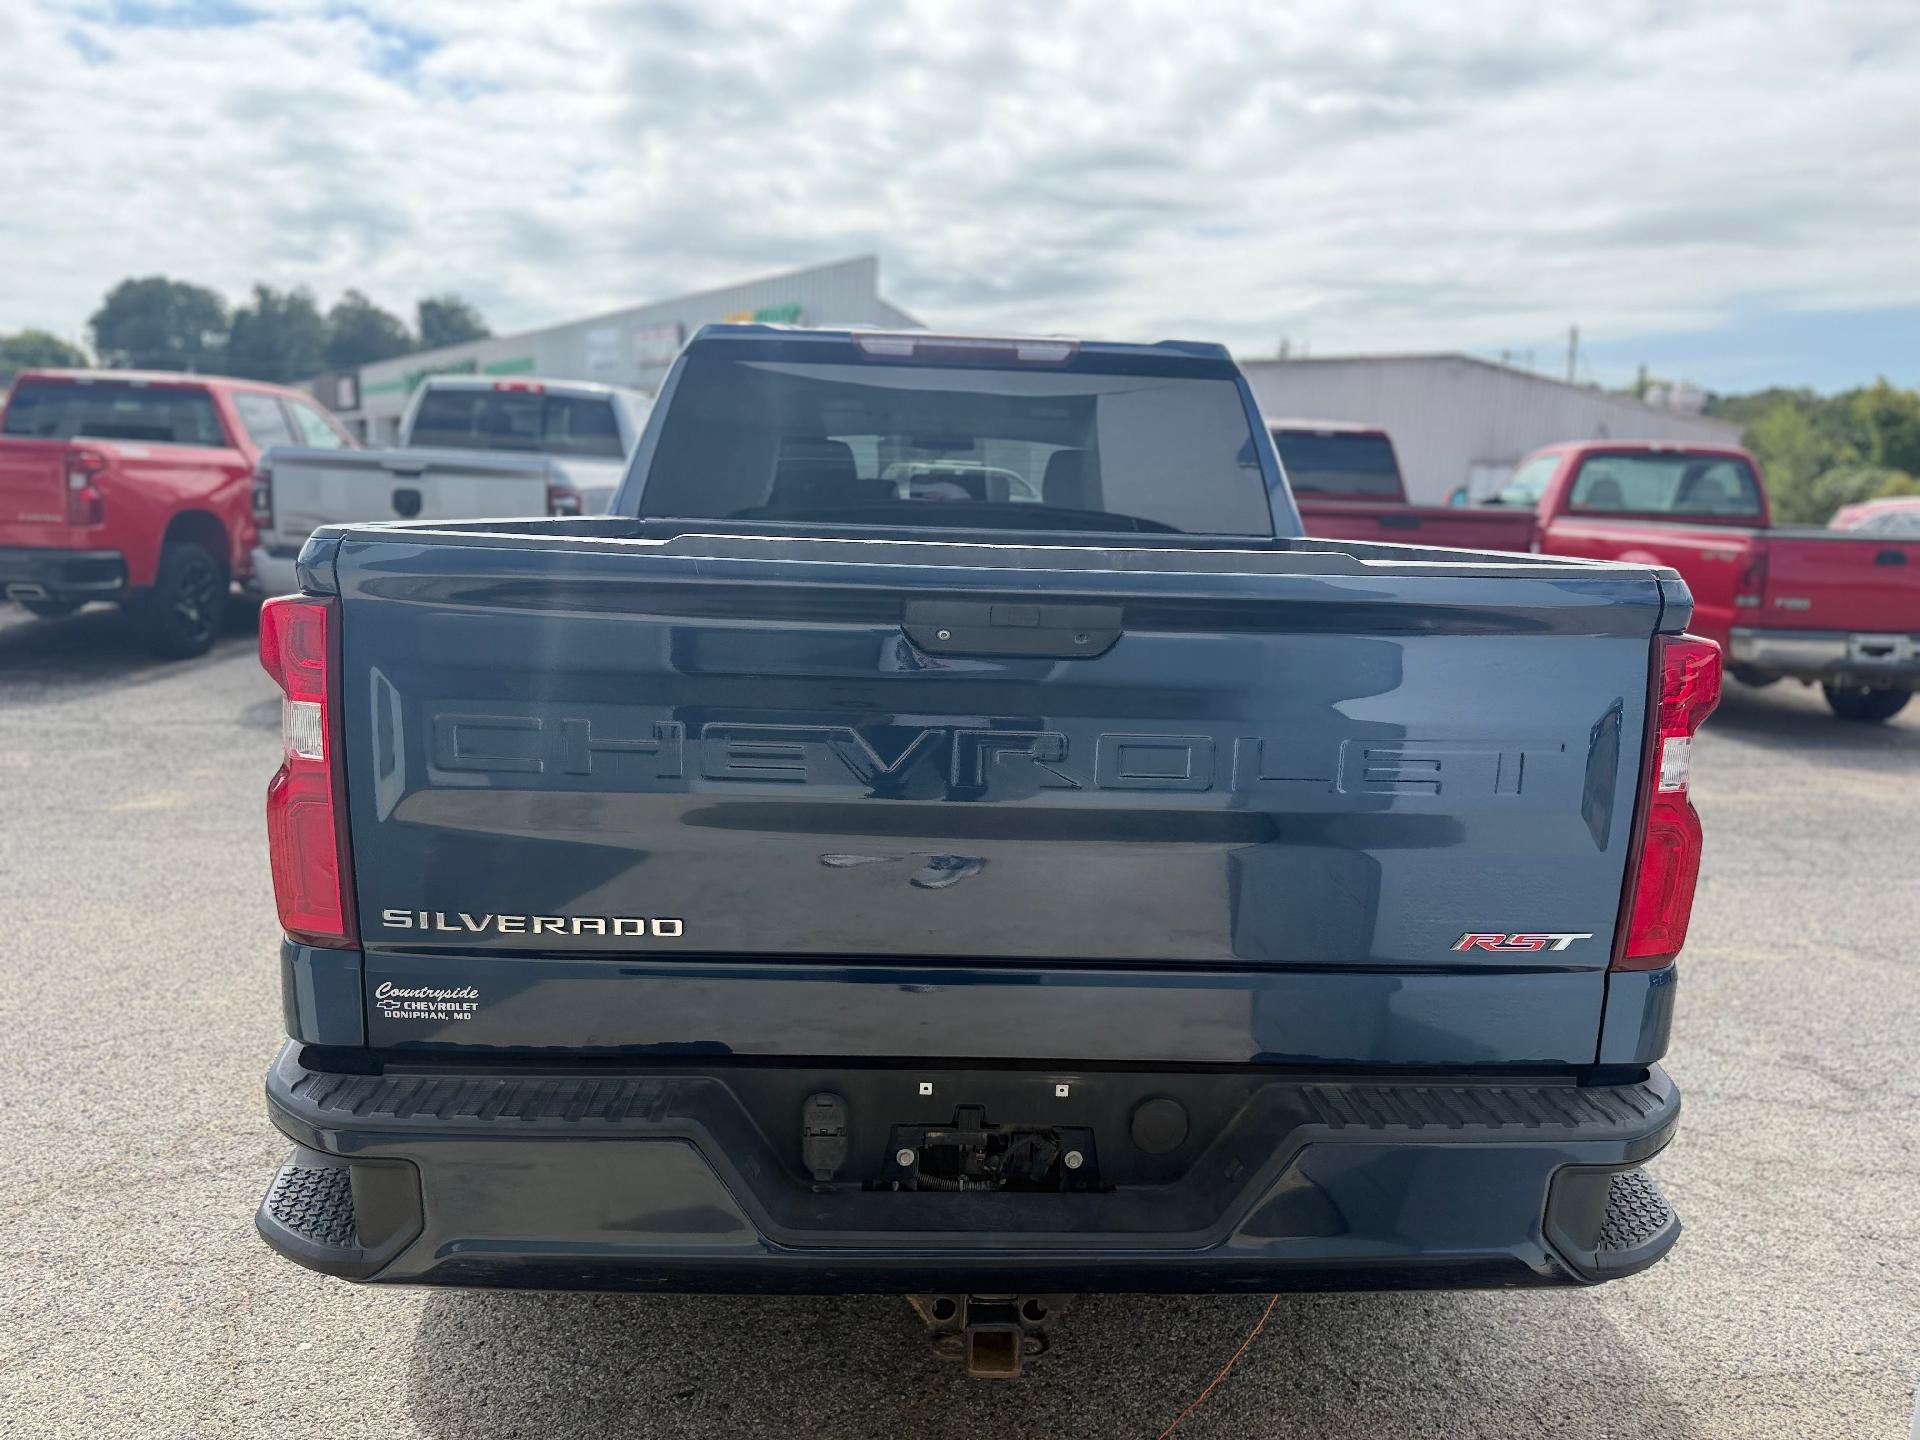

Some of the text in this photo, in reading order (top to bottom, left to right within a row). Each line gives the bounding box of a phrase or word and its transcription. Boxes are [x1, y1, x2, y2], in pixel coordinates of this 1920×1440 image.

[431, 713, 1566, 796] CHEVROLET
[382, 909, 685, 937] SILVERADO
[1450, 932, 1594, 953] RST
[374, 981, 480, 1002] Countryside
[384, 1010, 449, 1021] DONIPHAN,
[403, 1001, 479, 1011] CHEVROLET
